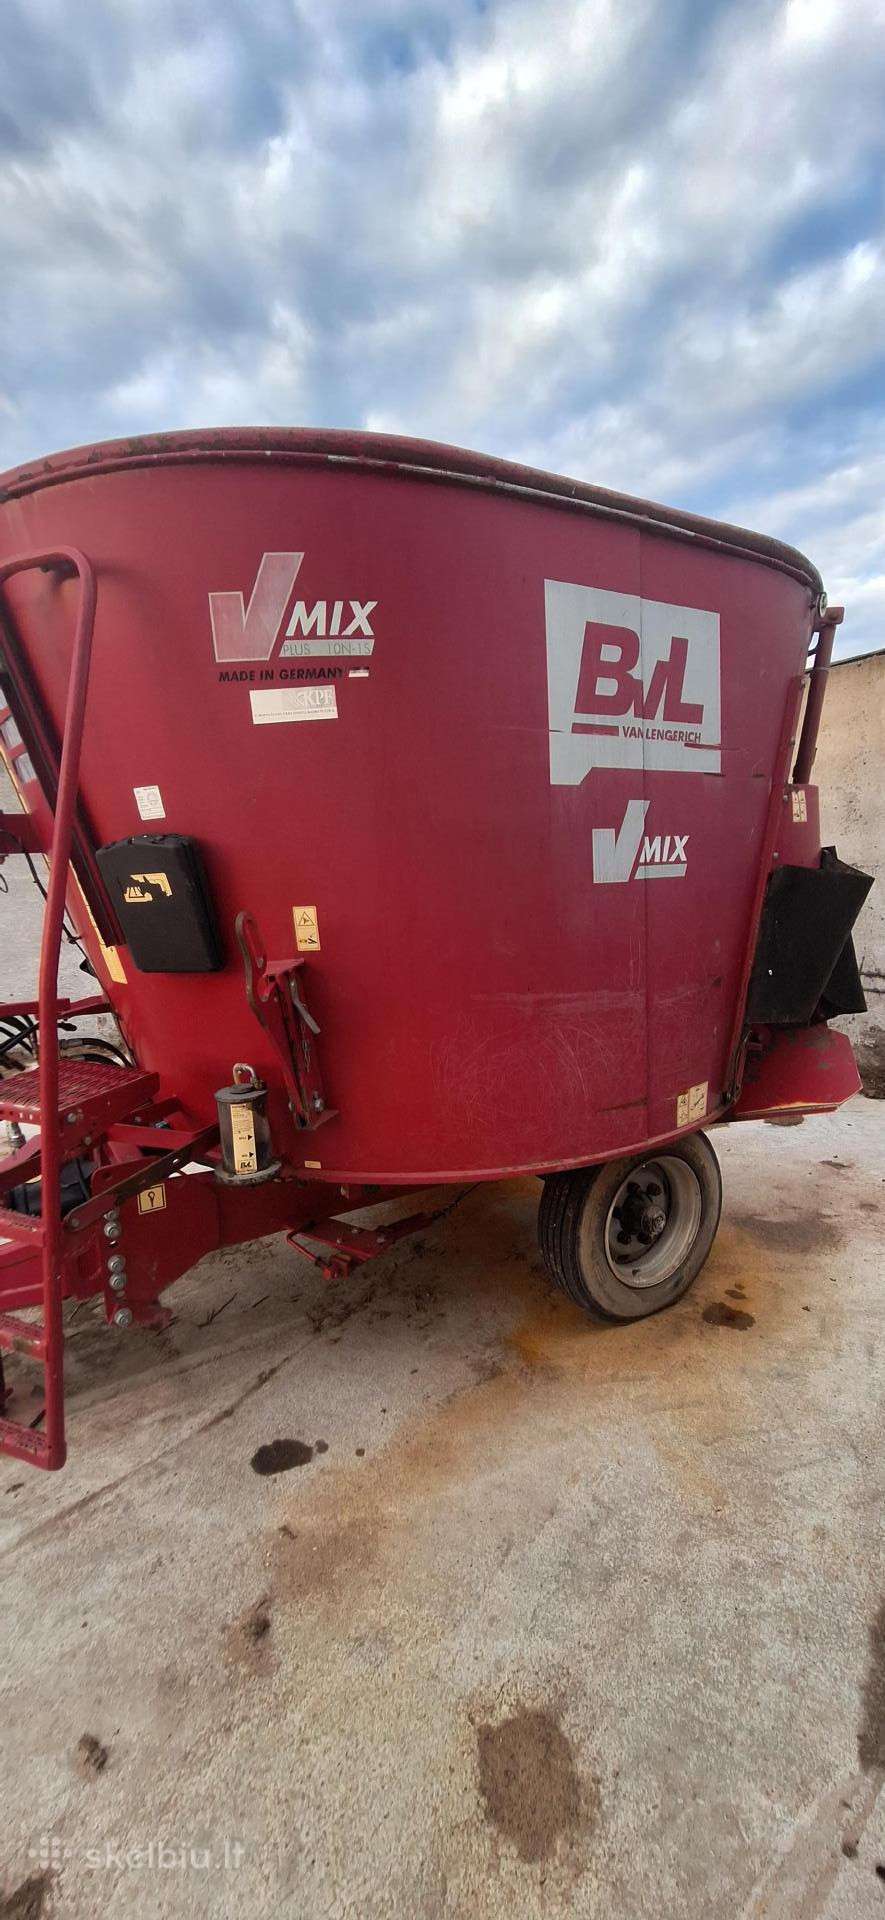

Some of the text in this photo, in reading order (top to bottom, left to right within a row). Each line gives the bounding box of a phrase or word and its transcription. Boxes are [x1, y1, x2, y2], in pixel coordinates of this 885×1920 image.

[285, 600, 378, 636] MIX
[283, 644, 311, 656] PLUS
[218, 667, 343, 682] MADE IN GERMANY
[639, 835, 690, 863] MIX
